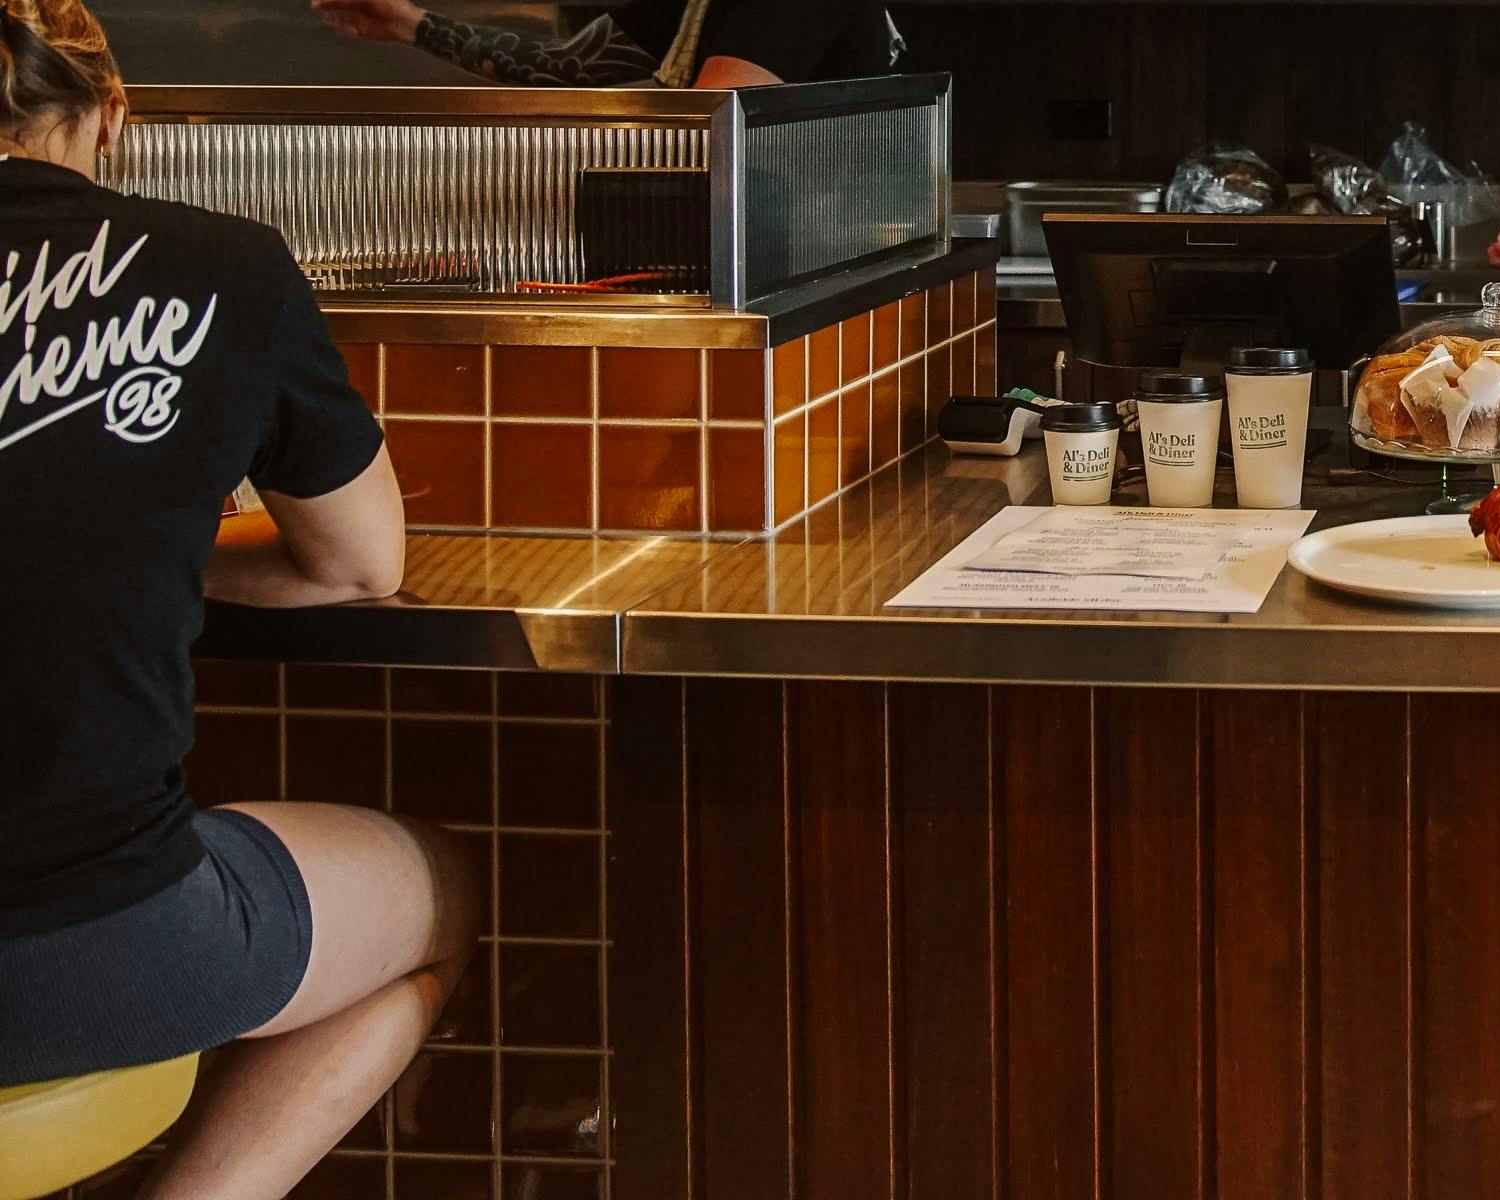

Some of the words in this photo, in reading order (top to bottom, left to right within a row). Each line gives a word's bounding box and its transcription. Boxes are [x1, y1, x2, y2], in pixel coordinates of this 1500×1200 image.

[110, 370, 182, 434] 98
[1238, 416, 1257, 430] Al's
[1259, 414, 1285, 427] Deli
[1148, 431, 1168, 445] Al's
[1170, 434, 1195, 446] Deli
[1239, 430, 1248, 441] &
[1250, 428, 1286, 441] Diner
[1087, 447, 1109, 461] Deli
[1148, 444, 1157, 455] &
[1158, 446, 1195, 459] Diner
[1063, 462, 1073, 473] &
[1075, 460, 1110, 474] Diner
